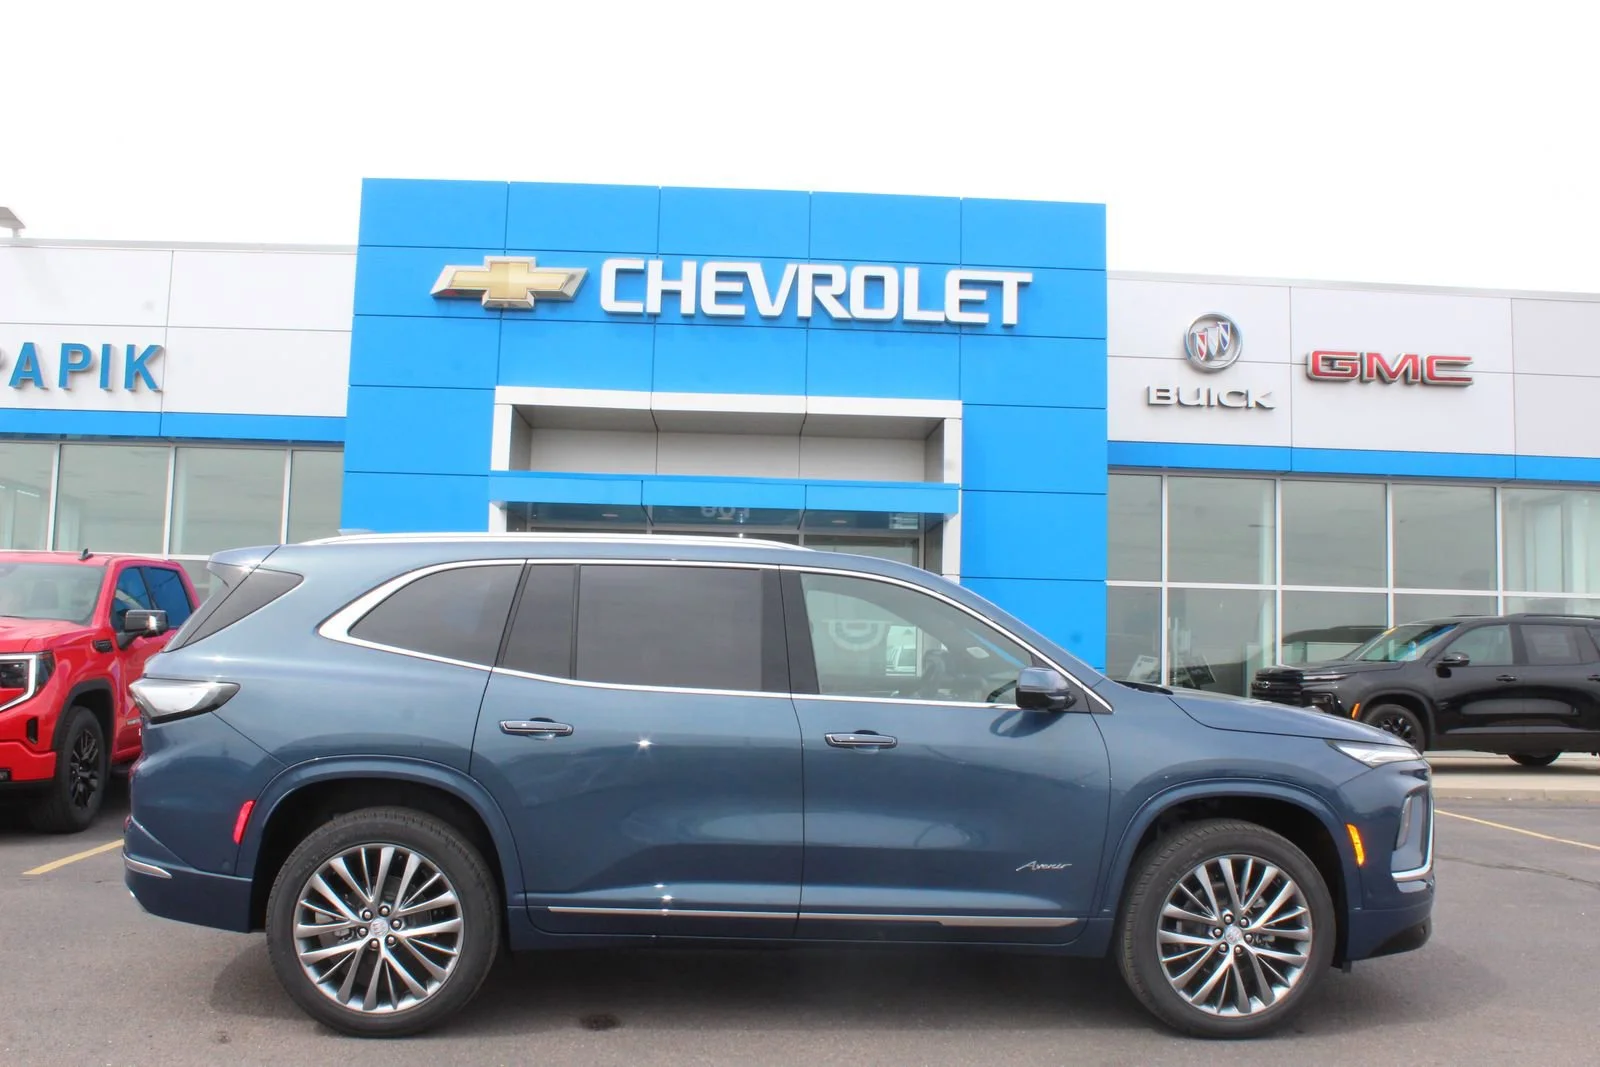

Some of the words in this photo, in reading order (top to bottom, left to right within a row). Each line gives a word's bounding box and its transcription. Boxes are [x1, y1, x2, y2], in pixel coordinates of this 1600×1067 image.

[600, 258, 1033, 327] CHEVROLET
[0, 342, 165, 392] APIK
[1306, 350, 1473, 386] GMC
[1146, 385, 1275, 410] BUICK
